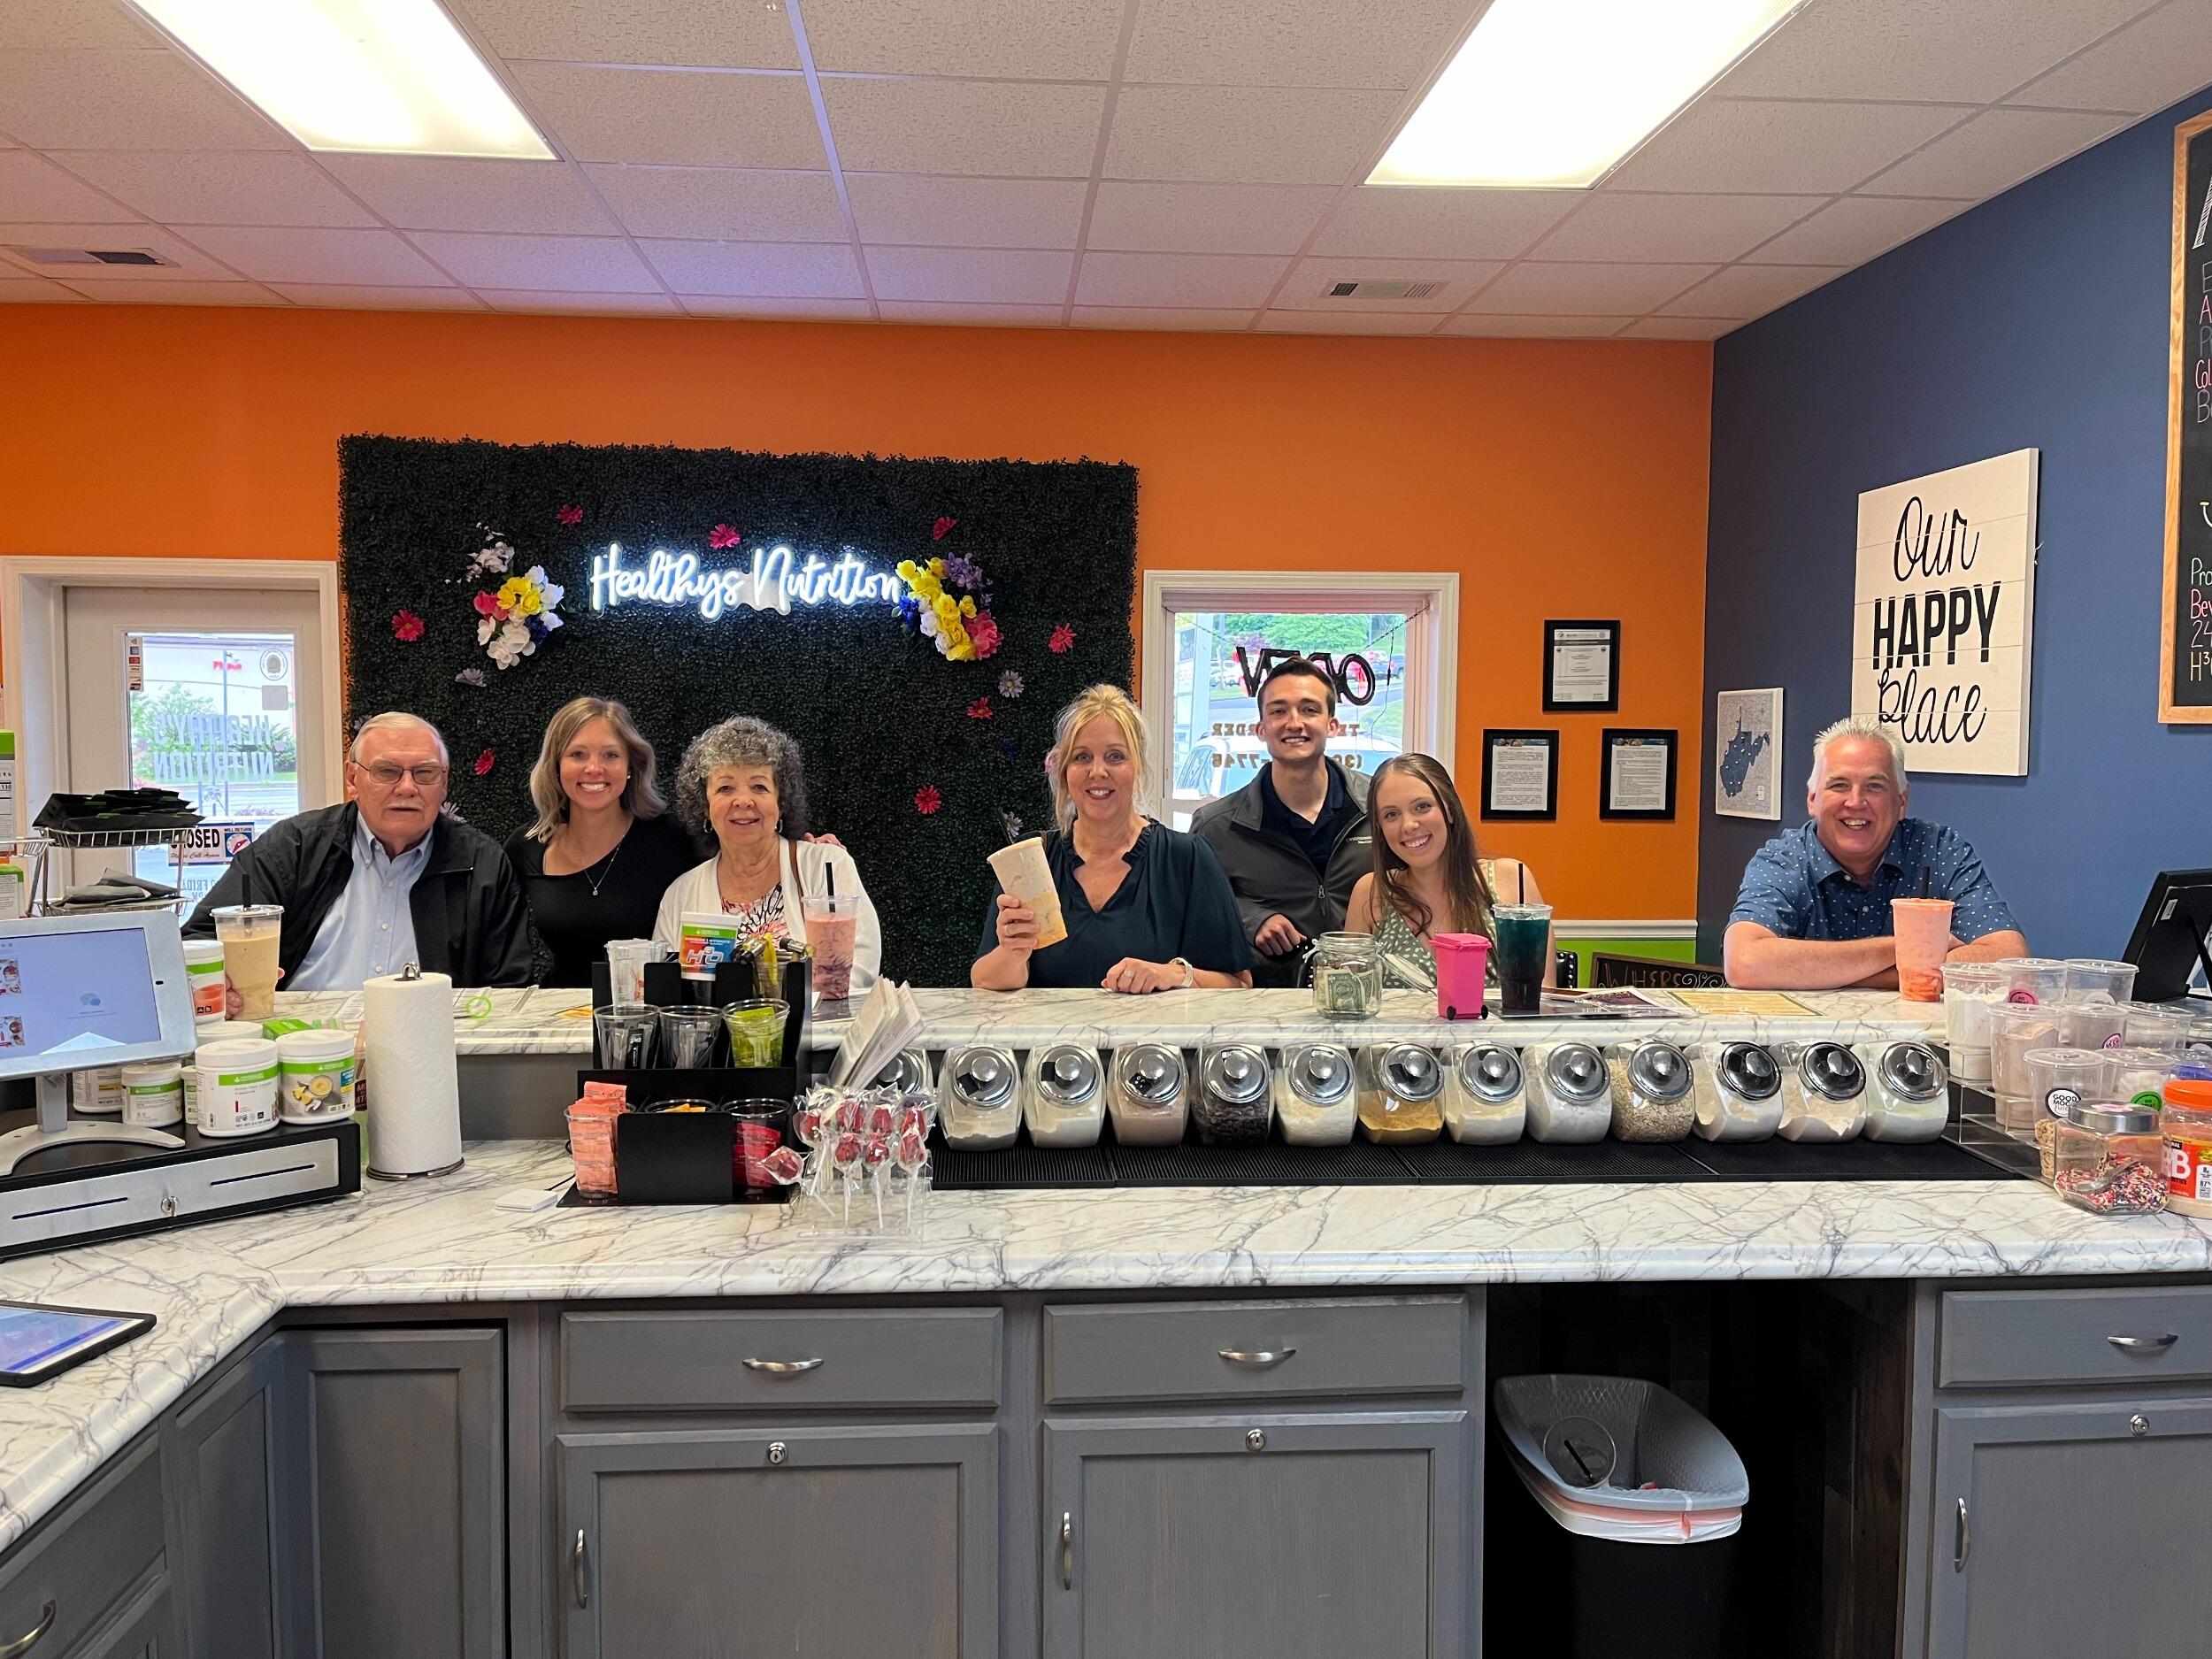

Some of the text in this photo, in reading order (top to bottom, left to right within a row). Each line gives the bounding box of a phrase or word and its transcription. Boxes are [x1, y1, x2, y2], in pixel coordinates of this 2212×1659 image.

[1893, 496, 1980, 581] Our
[590, 543, 901, 618] Healthys Nutrition
[1872, 580, 2002, 670] HAPPY
[171, 828, 220, 849] OSED
[2170, 1148, 2192, 1179] B
